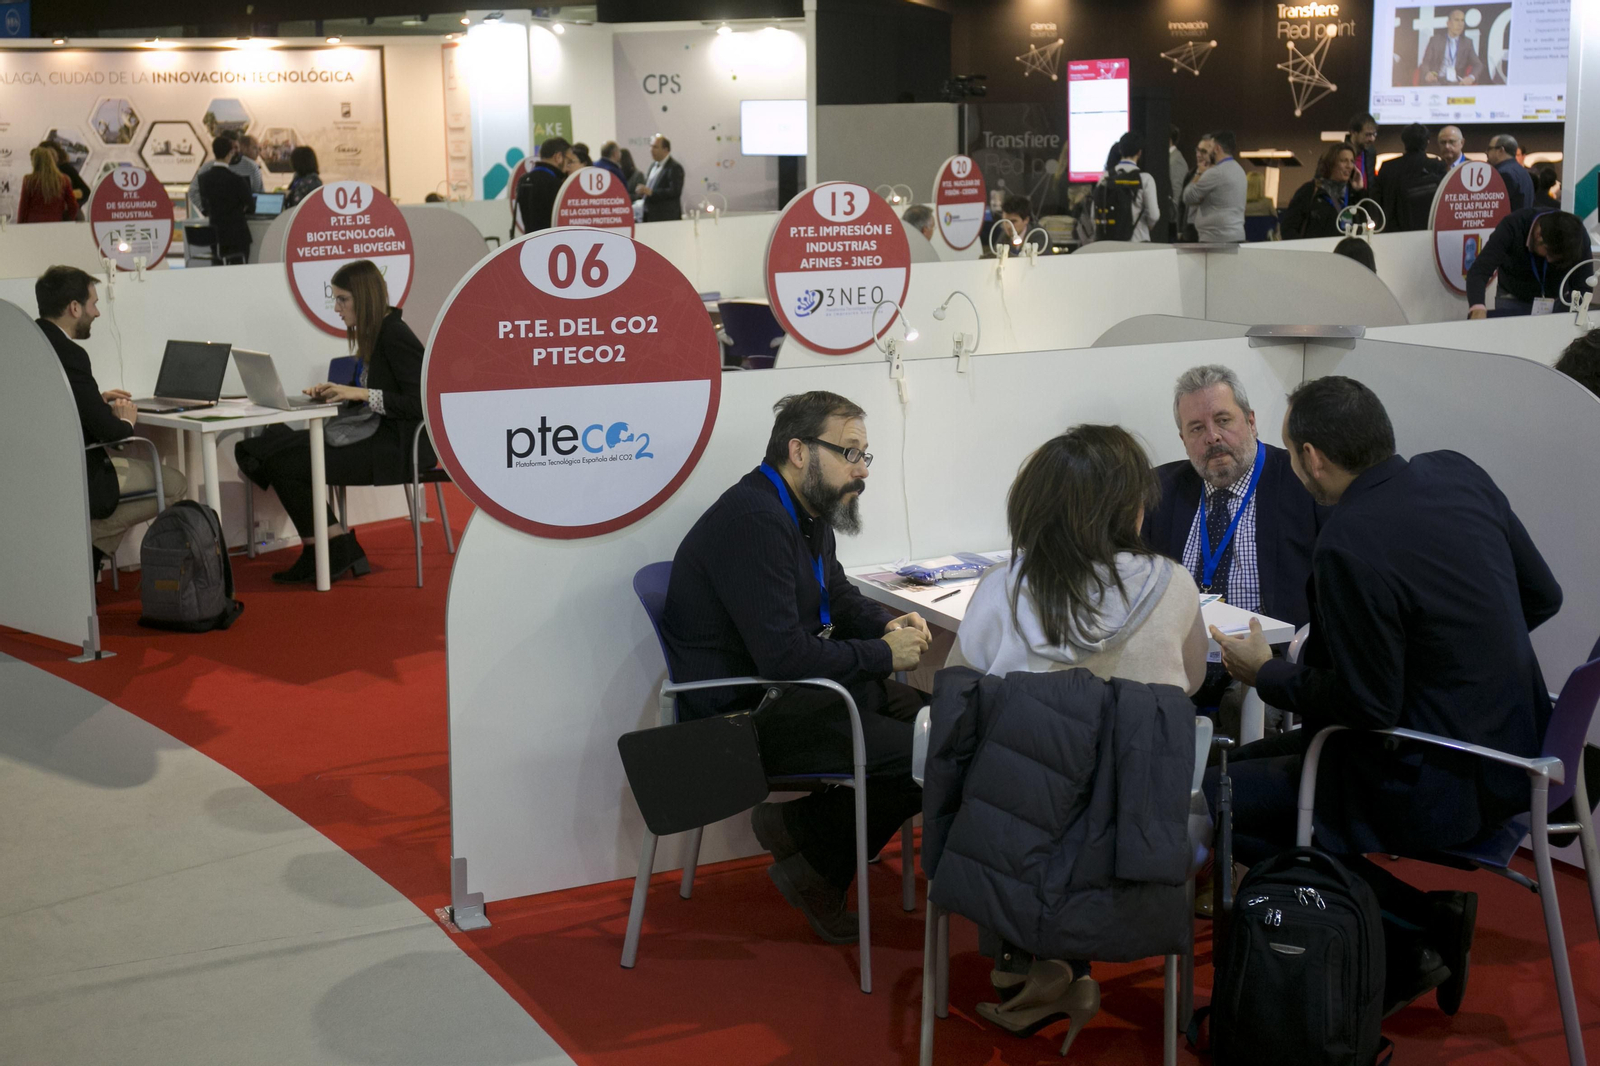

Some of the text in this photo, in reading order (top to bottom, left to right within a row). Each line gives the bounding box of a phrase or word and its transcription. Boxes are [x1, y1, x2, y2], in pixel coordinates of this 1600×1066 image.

[1277, 2, 1340, 19] Transfiere
[1030, 21, 1058, 31] ciencia
[1168, 20, 1210, 30] innovación
[1277, 19, 1356, 41] Red point
[49, 71, 105, 86] CIUDAD
[108, 71, 128, 85] DE
[131, 71, 149, 85] LA
[252, 67, 355, 84] TECNOLÓGICA
[643, 73, 682, 95] CPS
[534, 122, 563, 136] AKE
[982, 131, 1060, 149] Transfiere
[956, 160, 968, 175] 20
[121, 171, 139, 188] 30
[589, 173, 604, 191] 18
[1470, 167, 1485, 187] 16
[334, 186, 363, 210] 04
[589, 196, 625, 205] PROTECCIÓN
[831, 191, 856, 217] 13
[1459, 193, 1469, 201] DEL
[1470, 191, 1505, 201] HIDRÓGENO
[106, 201, 157, 210] DE SEGURIDAD
[560, 208, 569, 216] DE
[569, 208, 577, 216] LA
[601, 207, 611, 215] DEL
[612, 206, 630, 214] MEDIO
[1450, 203, 1455, 211] Y
[1463, 202, 1475, 210] LAS
[1475, 201, 1491, 209] PILAS
[1492, 200, 1500, 208] DE
[111, 211, 153, 220] INDUSTRIAL
[330, 215, 371, 227] P.T.E. DE
[569, 217, 591, 225] MARINO
[1454, 210, 1494, 219] COMBUSTIBLE
[306, 225, 396, 243] BIOTECNOLOGÍA
[789, 222, 893, 238] P.T.E. IMPRESIÓN E
[297, 244, 346, 258] VEGETAL
[353, 240, 406, 254] BIOVEGEN
[805, 240, 878, 253] INDUSTRIAS
[548, 243, 610, 289] 06
[799, 257, 843, 269] AFINES
[851, 255, 883, 267] 3NEO
[826, 285, 884, 307] 3NEO
[498, 315, 659, 339] P.T.E. DEL CO2
[532, 344, 627, 366] PTECO2
[515, 453, 633, 468] Plataforma Tecnológica Española del CO2
